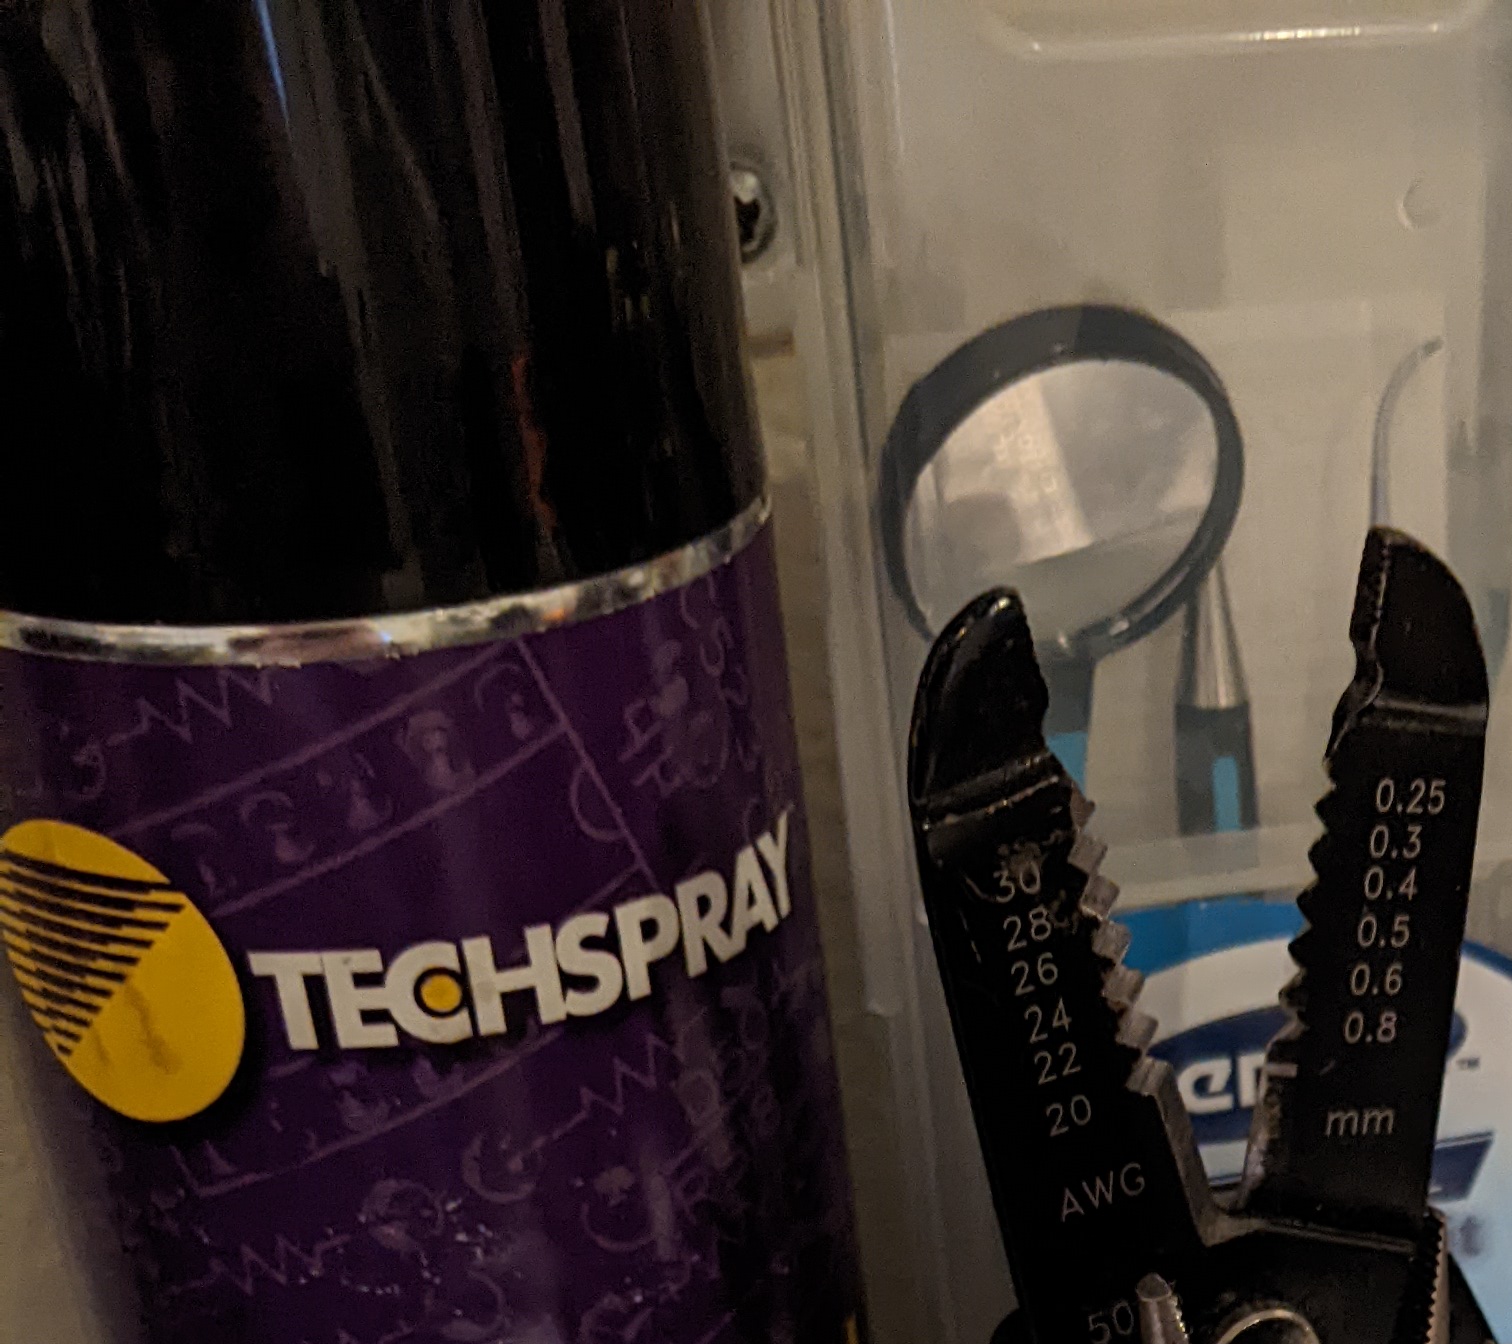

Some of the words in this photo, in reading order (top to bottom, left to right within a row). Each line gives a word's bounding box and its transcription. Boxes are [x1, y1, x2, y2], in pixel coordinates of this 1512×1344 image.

[1375, 777, 1447, 815] 0.25
[1369, 823, 1421, 860] 0.3
[996, 861, 1042, 902] 30
[1363, 865, 1419, 902] 0.4
[246, 803, 796, 1052] TECHSPRAY
[1003, 904, 1052, 953] 28
[1357, 911, 1411, 949] 0.5
[1011, 952, 1059, 997] 26
[1350, 962, 1403, 997] 0.6
[1023, 997, 1073, 1045] 24
[1343, 1009, 1398, 1044] 0.8
[1034, 1041, 1082, 1086] 22
[1046, 1094, 1093, 1138] 20
[1324, 1106, 1395, 1138] mm
[1060, 1161, 1147, 1222] AWG
